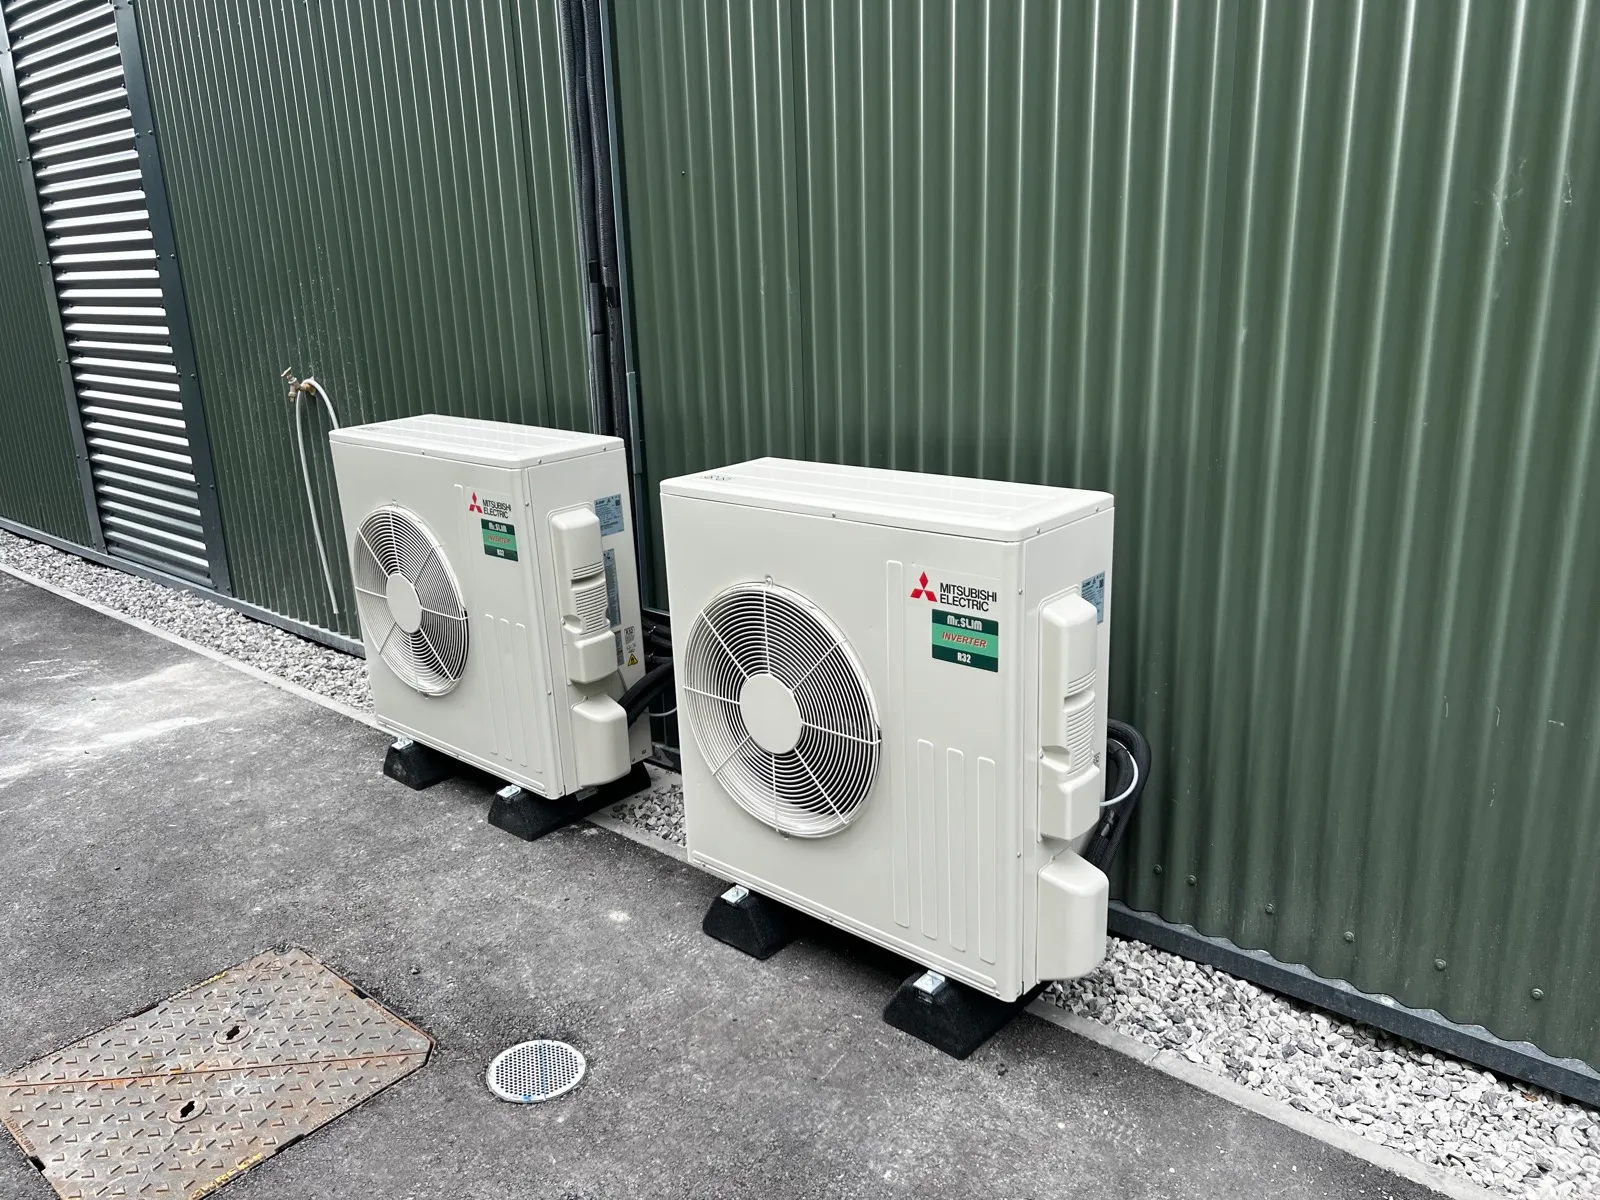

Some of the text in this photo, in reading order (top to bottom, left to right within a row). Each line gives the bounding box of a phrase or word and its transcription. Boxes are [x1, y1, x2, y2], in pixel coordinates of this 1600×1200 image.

[482, 499, 511, 512] MITSUBISHI
[483, 507, 509, 519] ELECTRIC
[940, 582, 997, 602] MITSUBISHI
[940, 594, 989, 612] ELECTRIC
[946, 614, 983, 631] Mr.SLIM
[942, 631, 987, 648] INVERTER
[957, 651, 971, 663] R32
